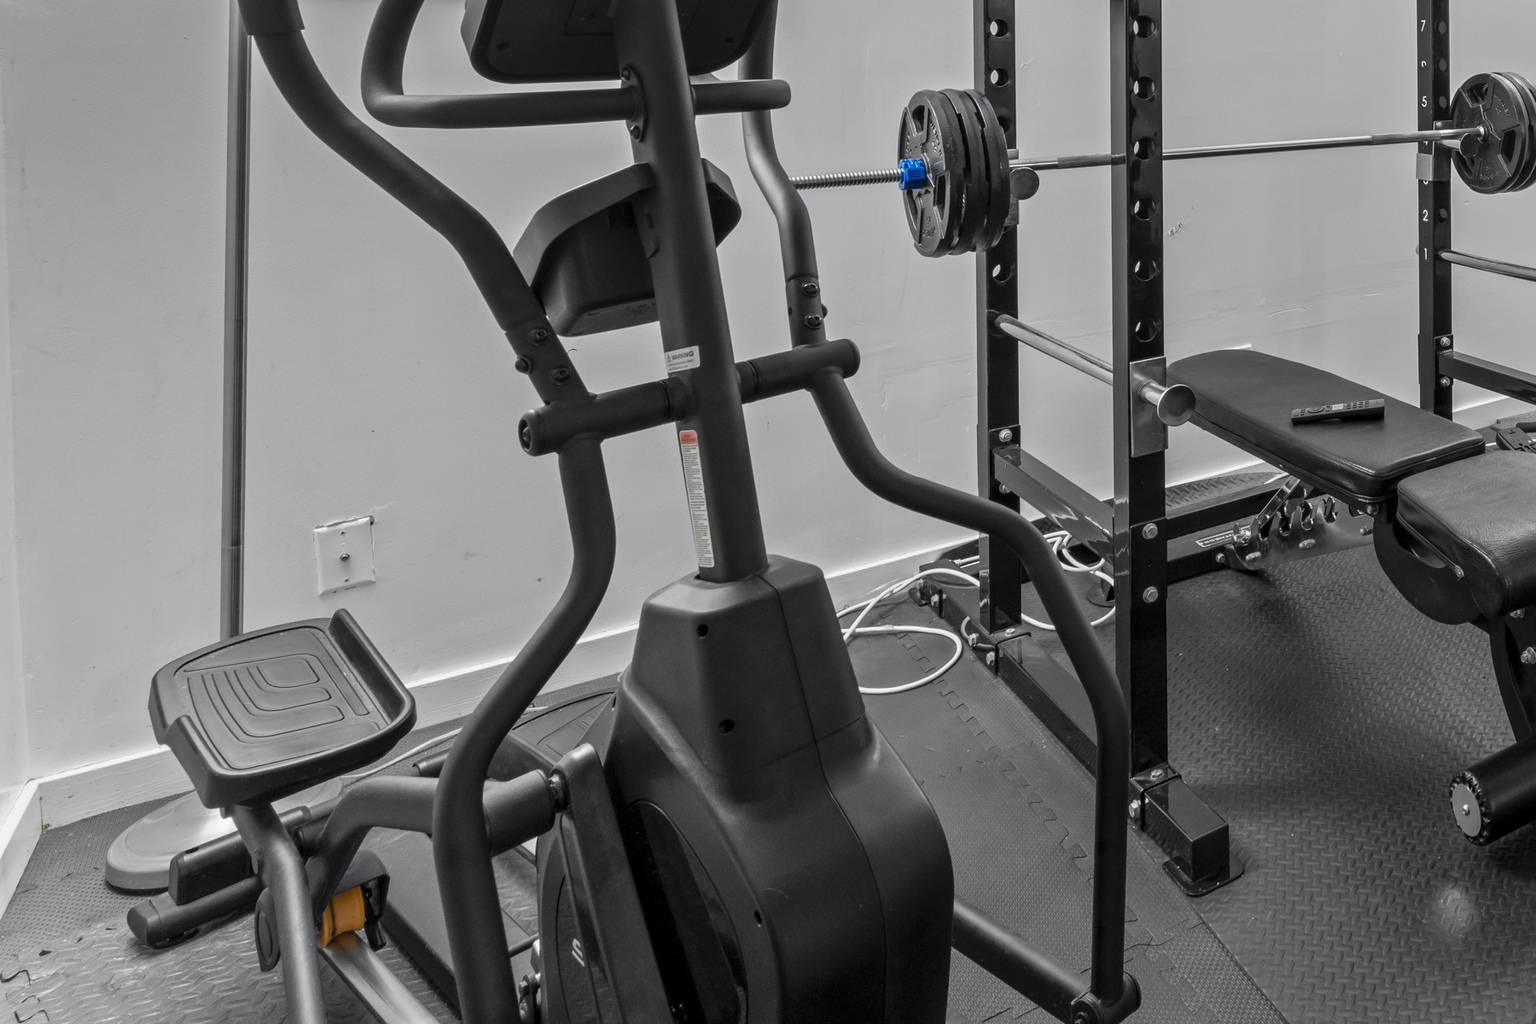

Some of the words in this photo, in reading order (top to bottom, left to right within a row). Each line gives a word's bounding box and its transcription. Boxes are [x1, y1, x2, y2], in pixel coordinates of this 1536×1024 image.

[1420, 19, 1427, 32] 7
[1420, 95, 1428, 108] 5
[1422, 209, 1429, 222] 2
[1423, 247, 1428, 260] 1
